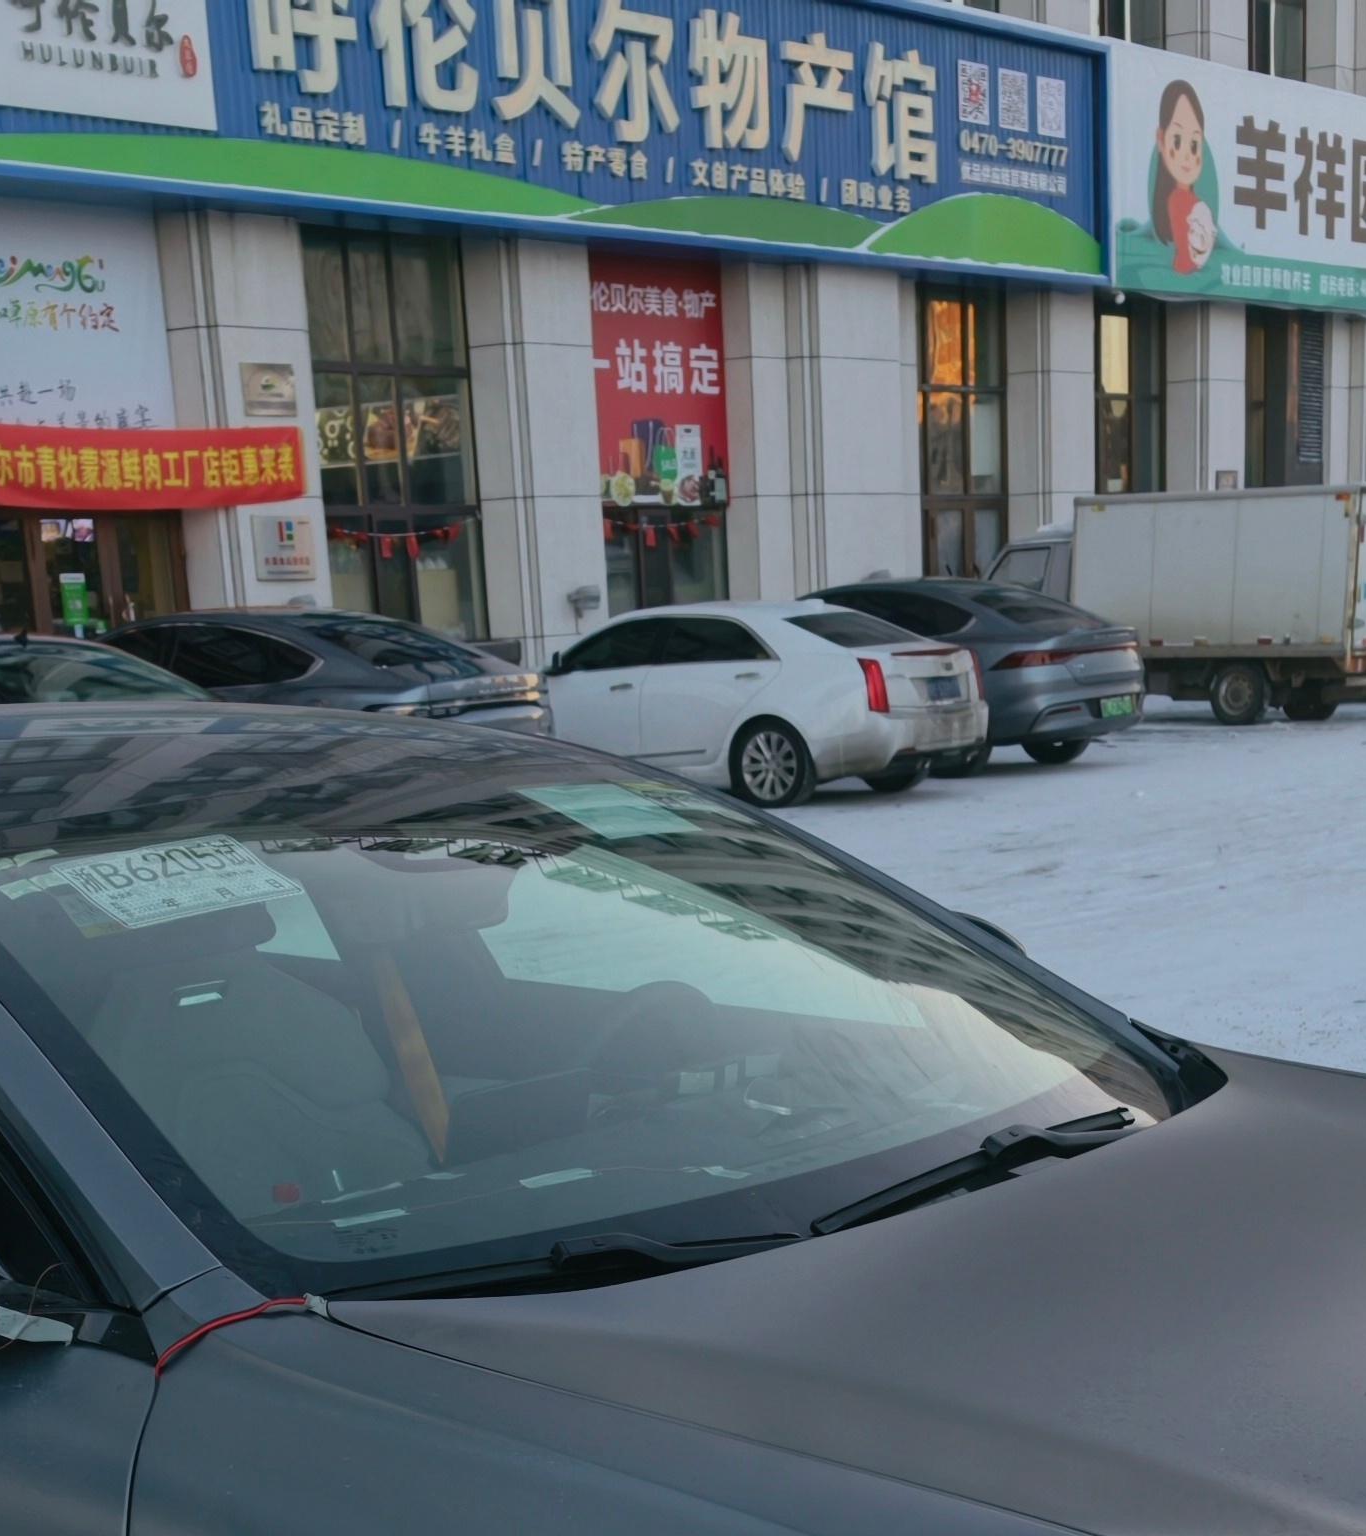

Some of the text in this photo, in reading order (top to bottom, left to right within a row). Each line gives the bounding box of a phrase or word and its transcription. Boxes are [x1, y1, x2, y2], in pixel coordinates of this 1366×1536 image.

[20, 41, 160, 79] HULUNBUIR
[247, 0, 937, 184] 呼伦贝尔物产馆
[259, 101, 911, 214] 礼品定制 牛羊礼盒 特产零食 文创产品体验 团购业务
